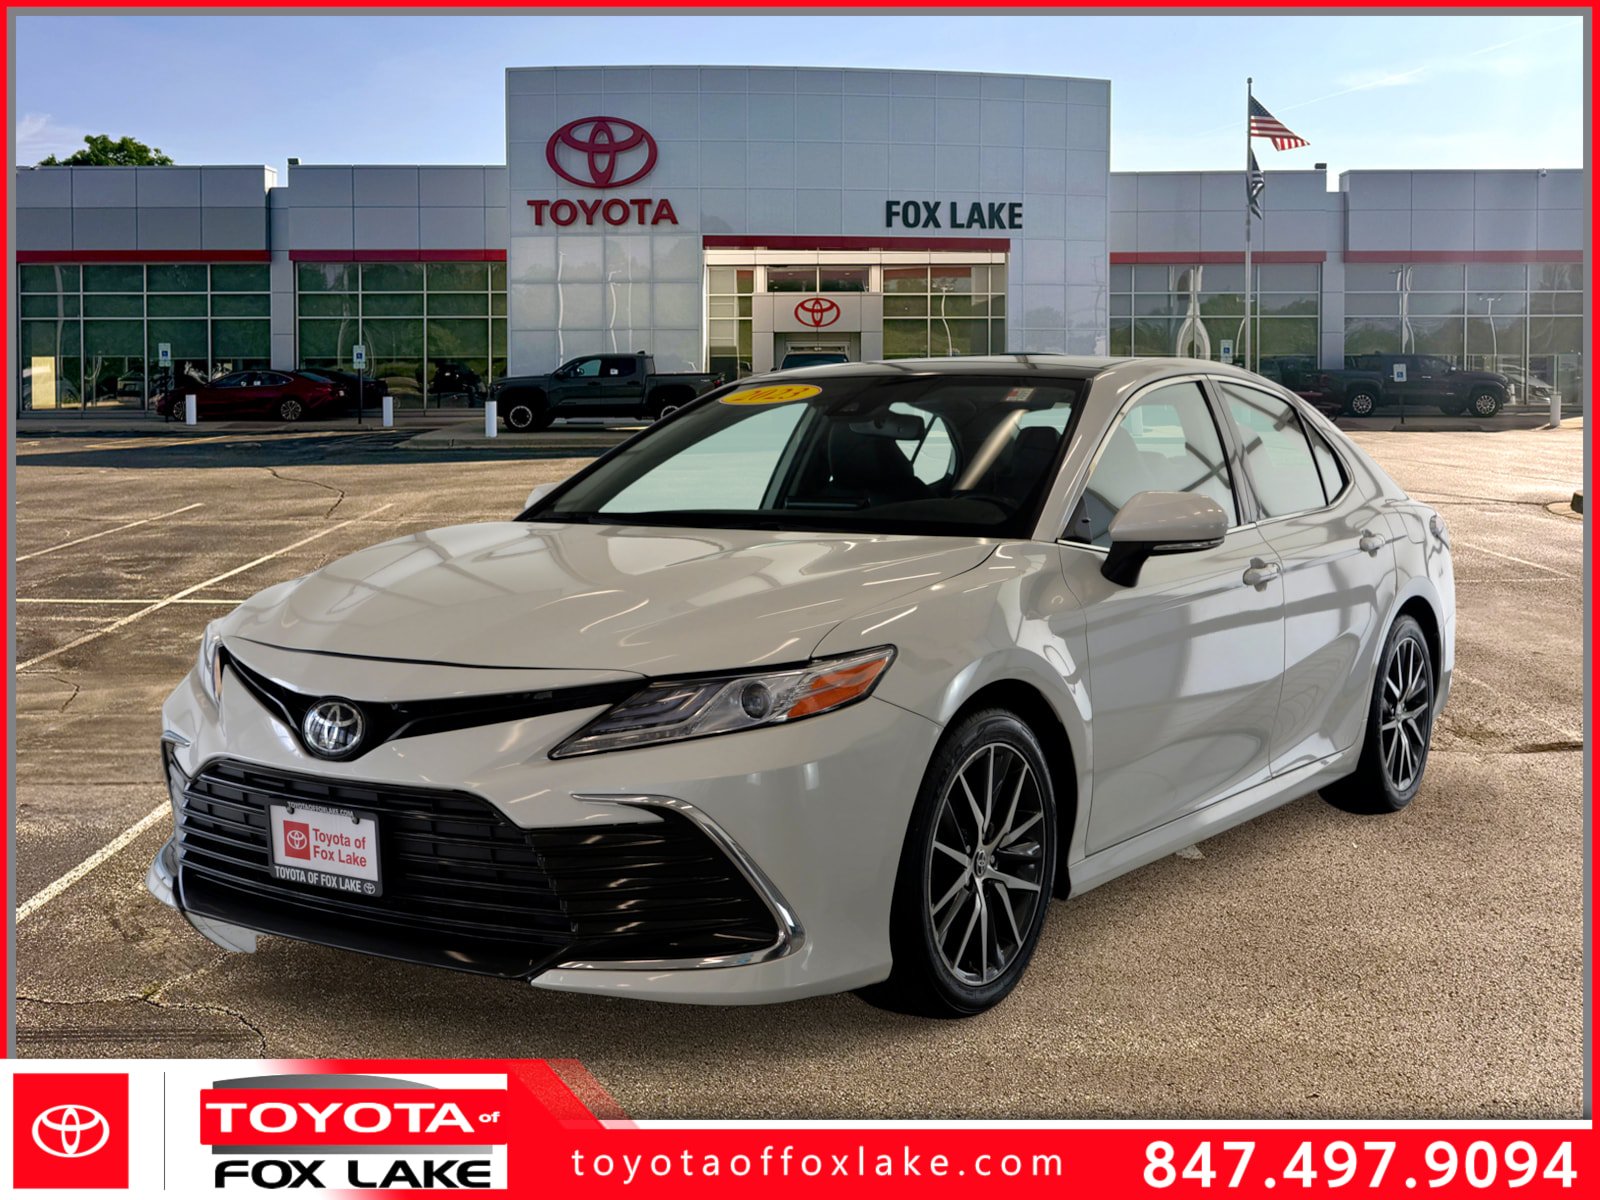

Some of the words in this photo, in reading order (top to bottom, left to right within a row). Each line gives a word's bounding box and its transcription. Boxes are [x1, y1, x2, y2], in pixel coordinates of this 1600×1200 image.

[527, 199, 678, 227] TOYOTA
[885, 200, 942, 229] FOX
[950, 201, 1023, 230] LAKE
[731, 387, 810, 401] 2023
[312, 828, 351, 847] Toyota
[354, 837, 366, 849] of
[313, 845, 335, 861] Fox
[338, 849, 367, 867] Lake
[274, 865, 306, 883] TOYOTA
[308, 872, 319, 885] OF
[321, 874, 338, 888] FOX
[340, 876, 362, 893] LAKE
